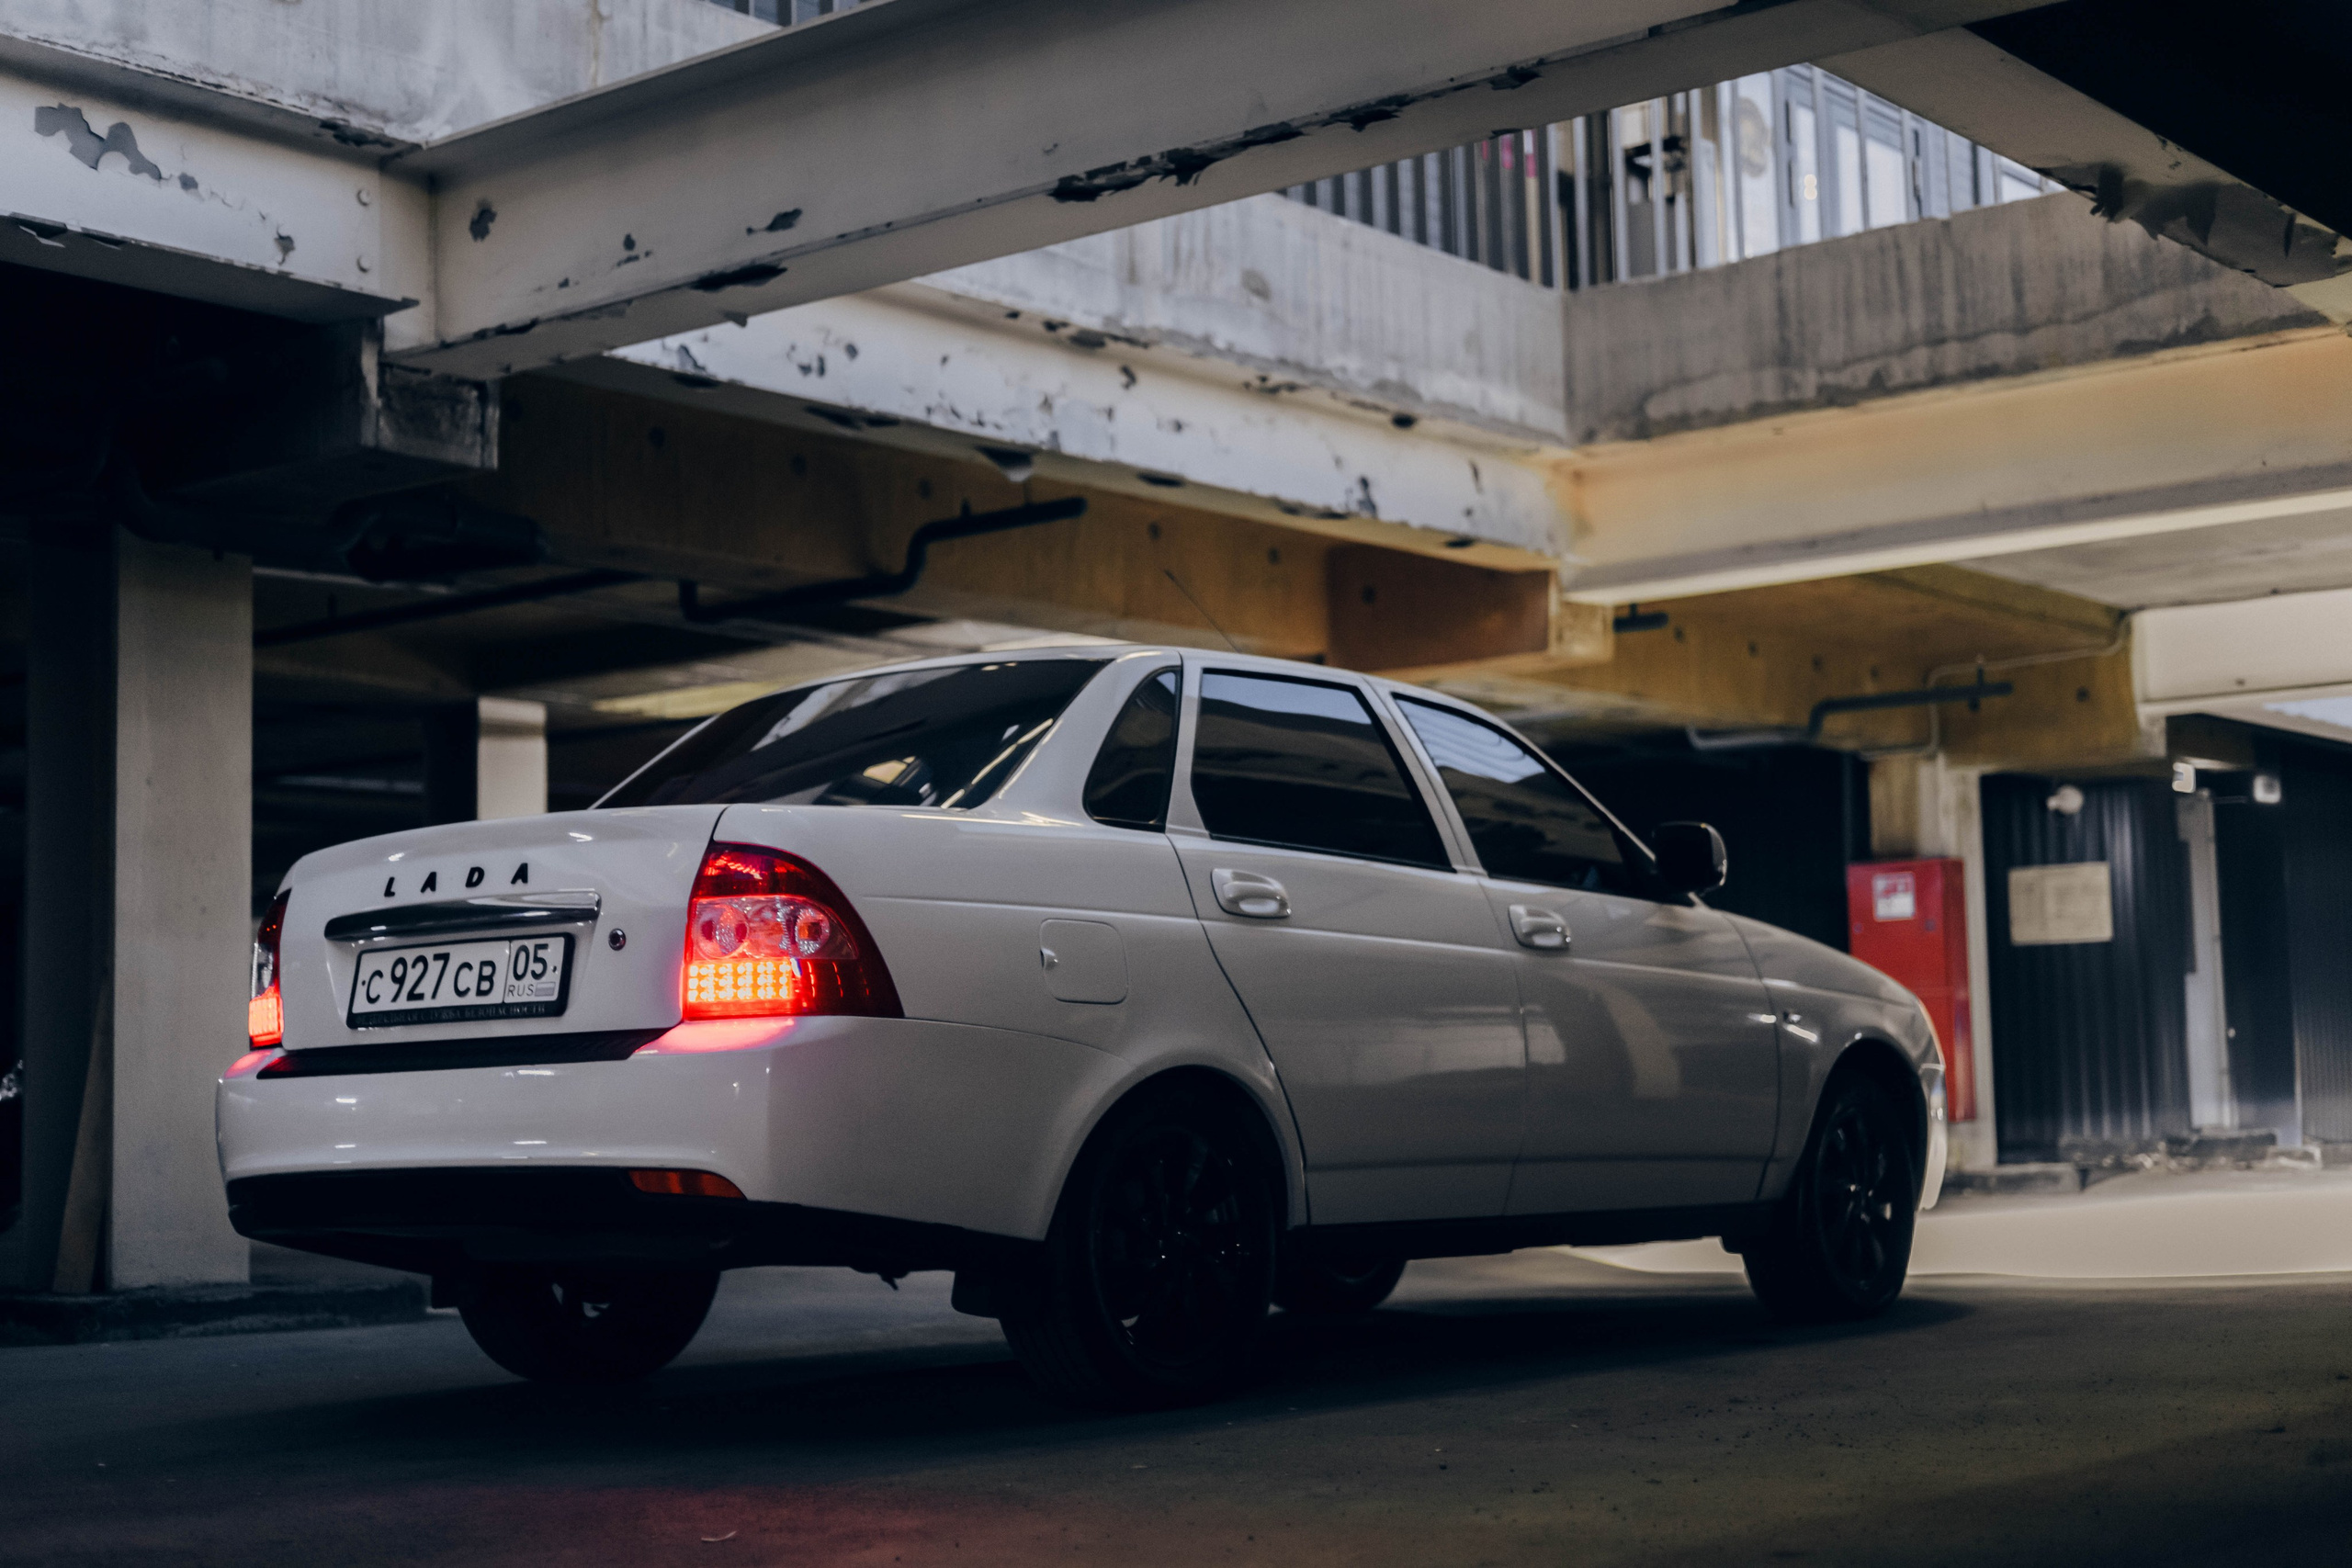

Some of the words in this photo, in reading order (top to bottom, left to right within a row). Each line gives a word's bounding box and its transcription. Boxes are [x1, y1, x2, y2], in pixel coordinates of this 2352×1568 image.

[383, 863, 528, 897] LADA
[513, 943, 549, 981] 05
[506, 984, 535, 998] RUS
